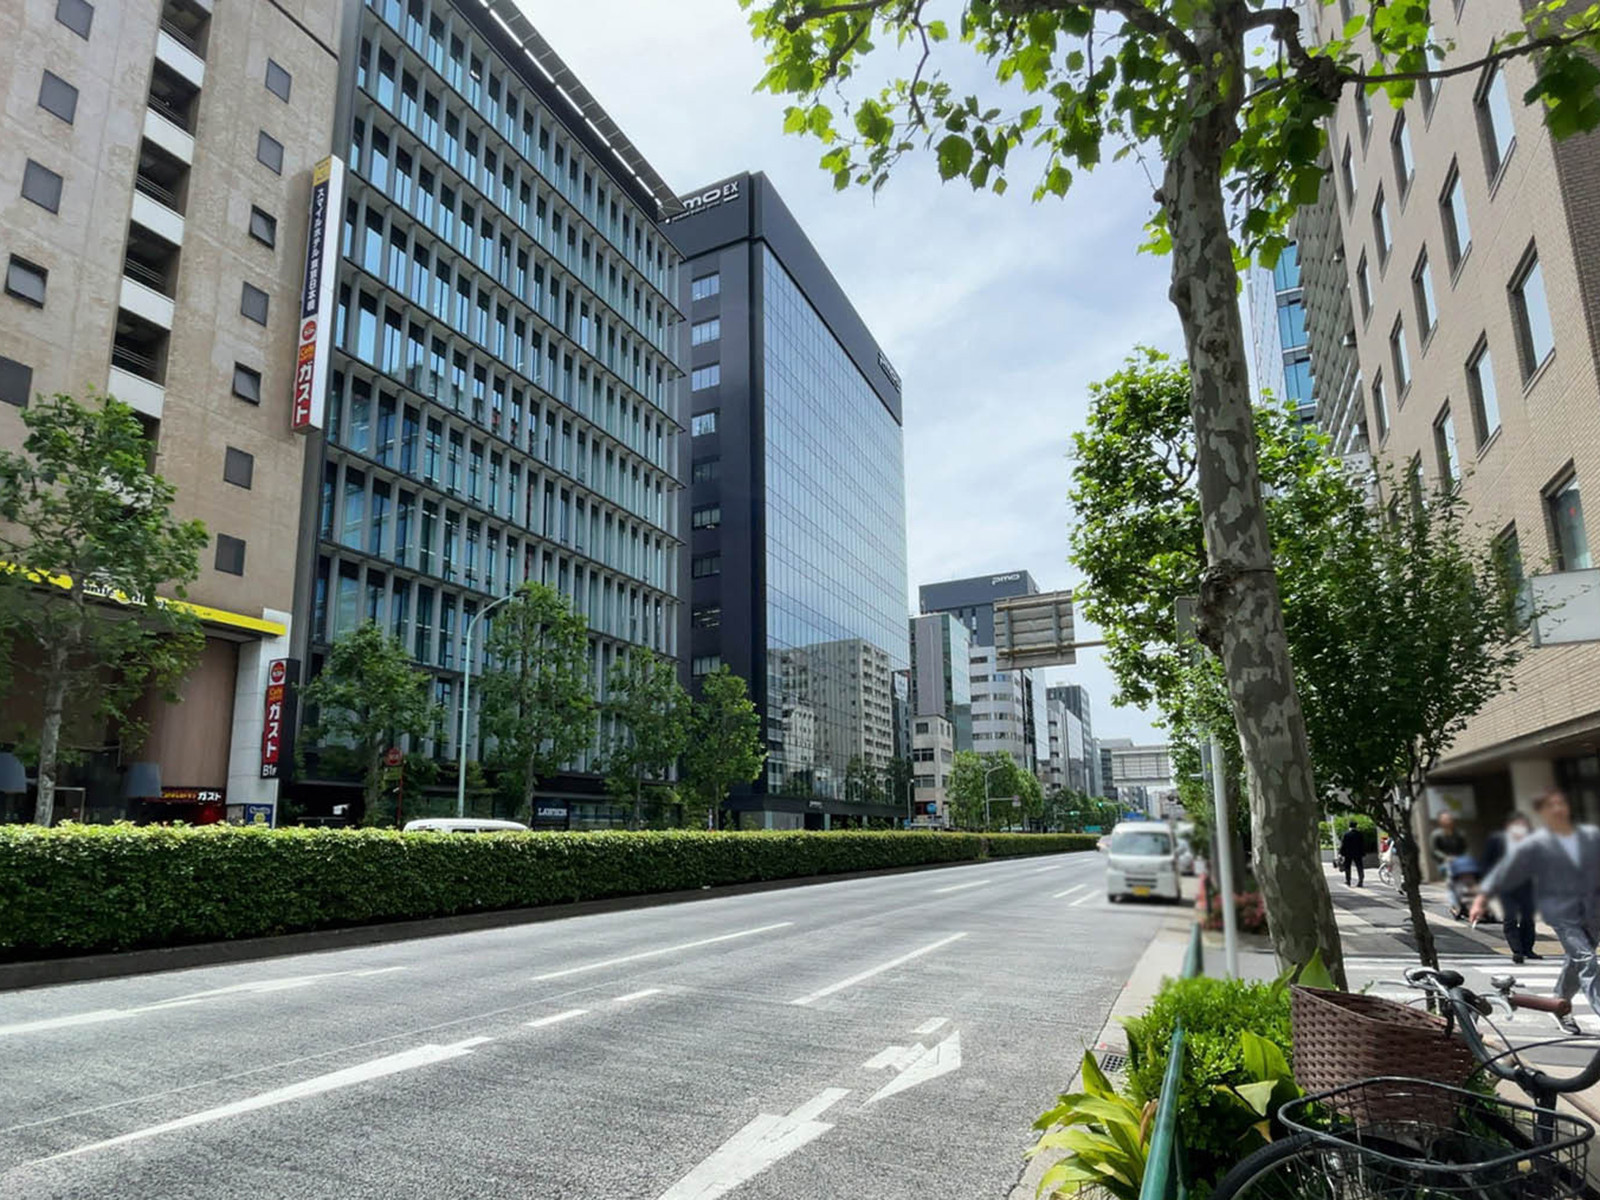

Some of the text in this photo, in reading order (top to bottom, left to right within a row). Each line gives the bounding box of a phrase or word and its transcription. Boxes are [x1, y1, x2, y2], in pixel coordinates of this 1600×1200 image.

[723, 181, 738, 195] EX
[296, 361, 313, 424] ガスト
[266, 702, 281, 758] ガスト
[197, 791, 222, 801] ガスト
